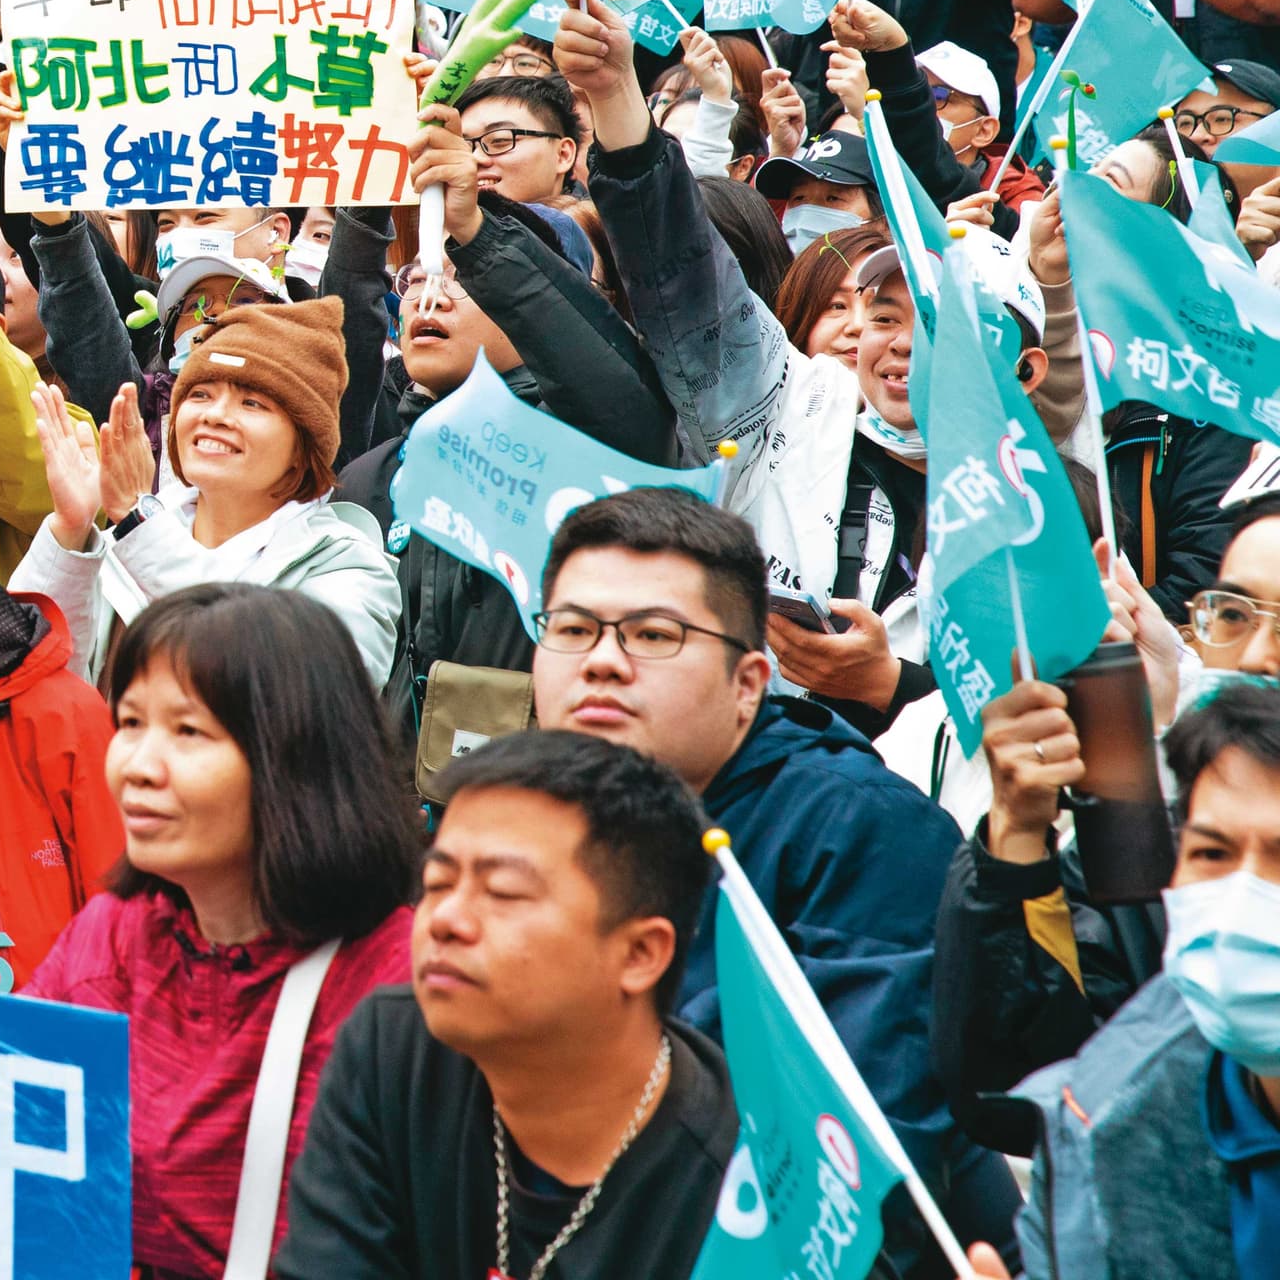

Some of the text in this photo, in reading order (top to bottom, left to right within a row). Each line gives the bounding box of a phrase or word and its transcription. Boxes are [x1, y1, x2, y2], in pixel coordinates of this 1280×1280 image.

[20, 111, 410, 207] 要繼續努力
[1178, 309, 1257, 352] Promise
[727, 414, 767, 443] Notepa
